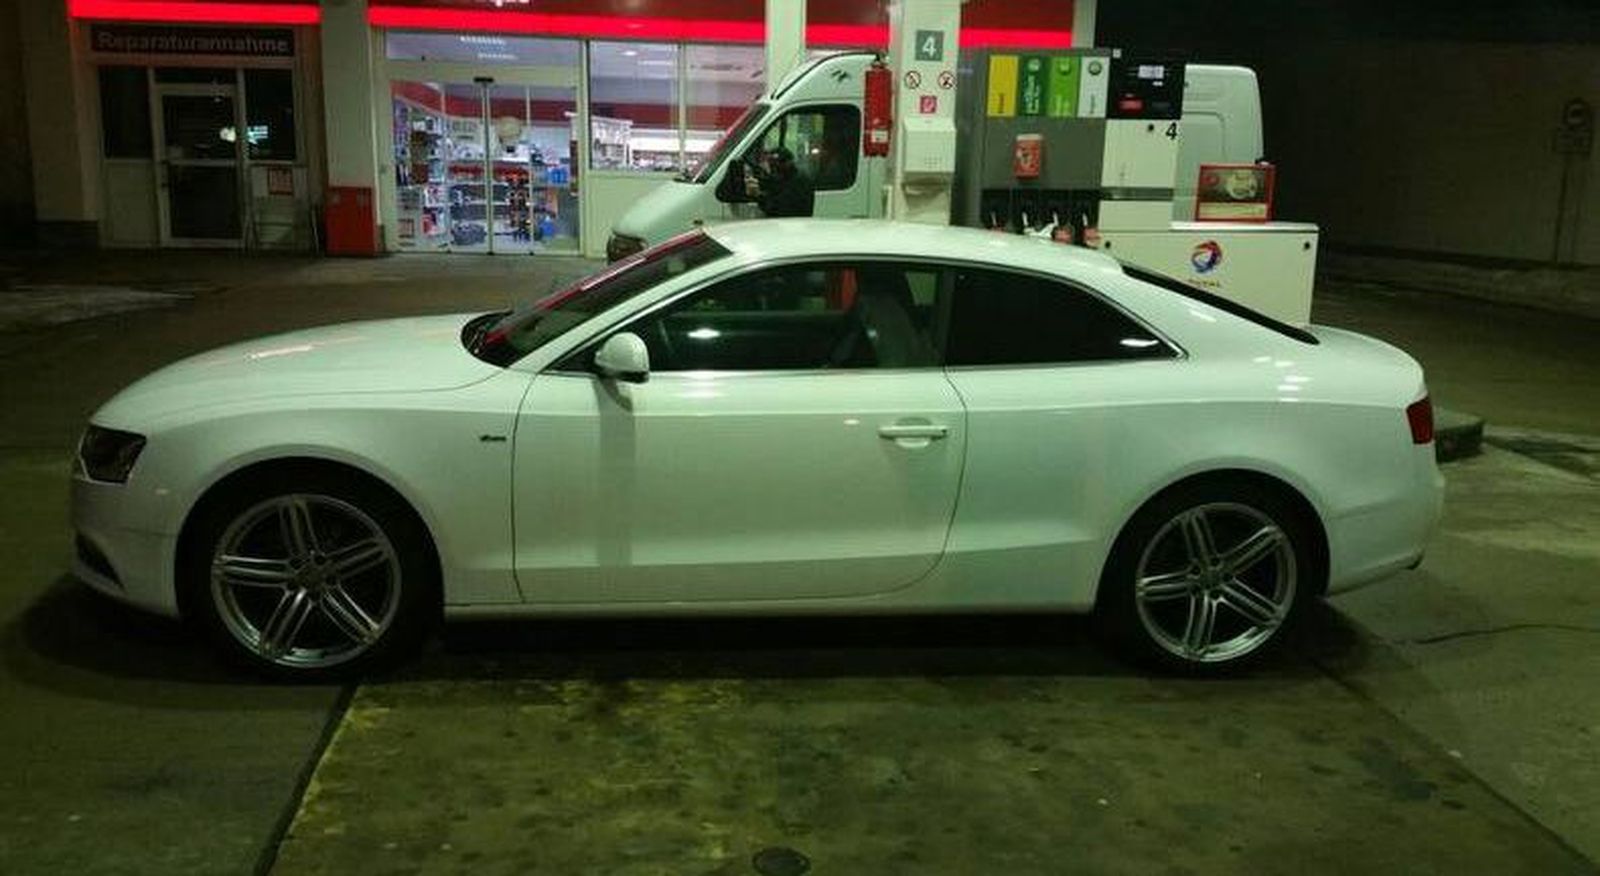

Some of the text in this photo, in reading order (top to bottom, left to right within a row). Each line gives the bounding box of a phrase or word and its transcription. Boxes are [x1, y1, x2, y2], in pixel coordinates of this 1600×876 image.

[97, 31, 289, 52] Reparaturannahme
[922, 36, 937, 57] 4
[1165, 122, 1177, 140] 4
